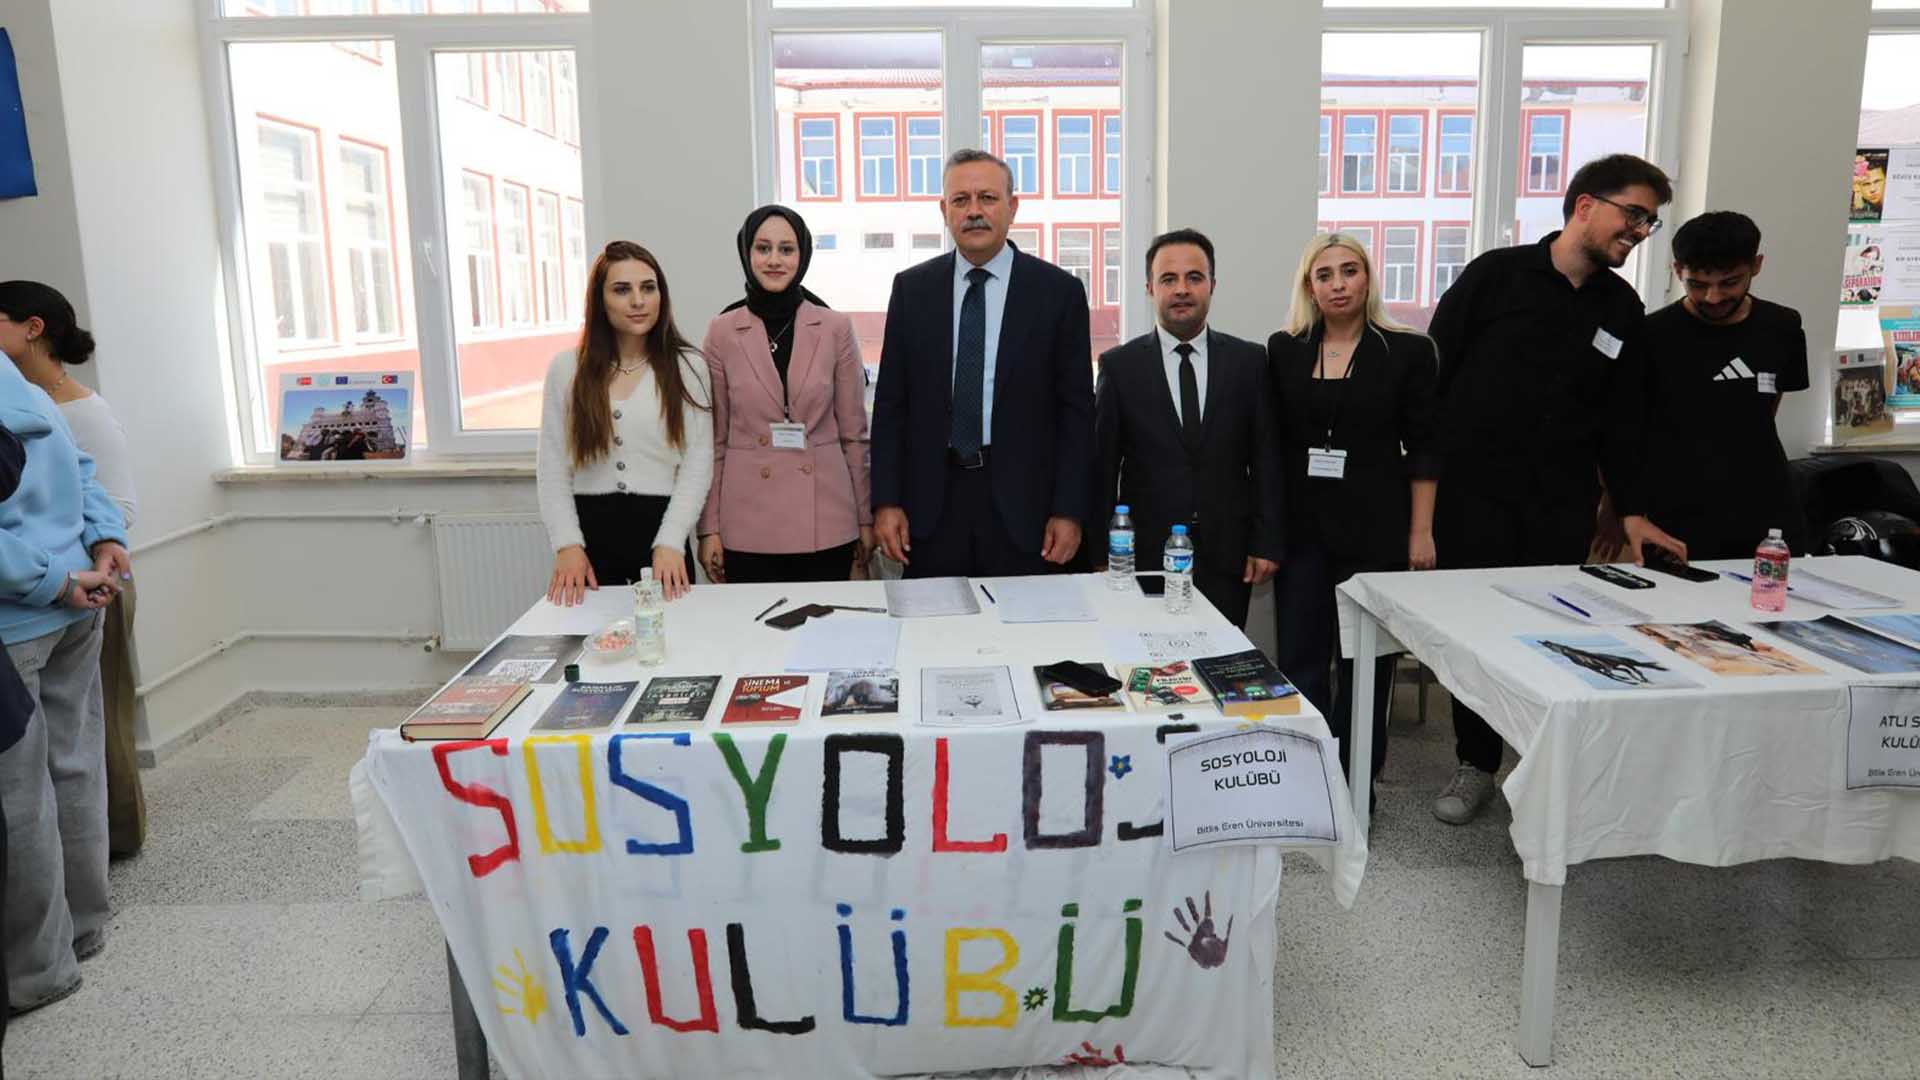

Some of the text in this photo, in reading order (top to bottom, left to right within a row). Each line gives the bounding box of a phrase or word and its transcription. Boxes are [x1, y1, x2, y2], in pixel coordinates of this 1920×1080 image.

[1880, 715, 1908, 727] ATLI
[1881, 734, 1920, 749] KULÜ
[1214, 770, 1281, 791] KULÜBÜ
[1221, 822, 1244, 831] Eren
[1245, 818, 1304, 829] Üniversitesi
[550, 898, 1143, 1036] KULÜBÜ
